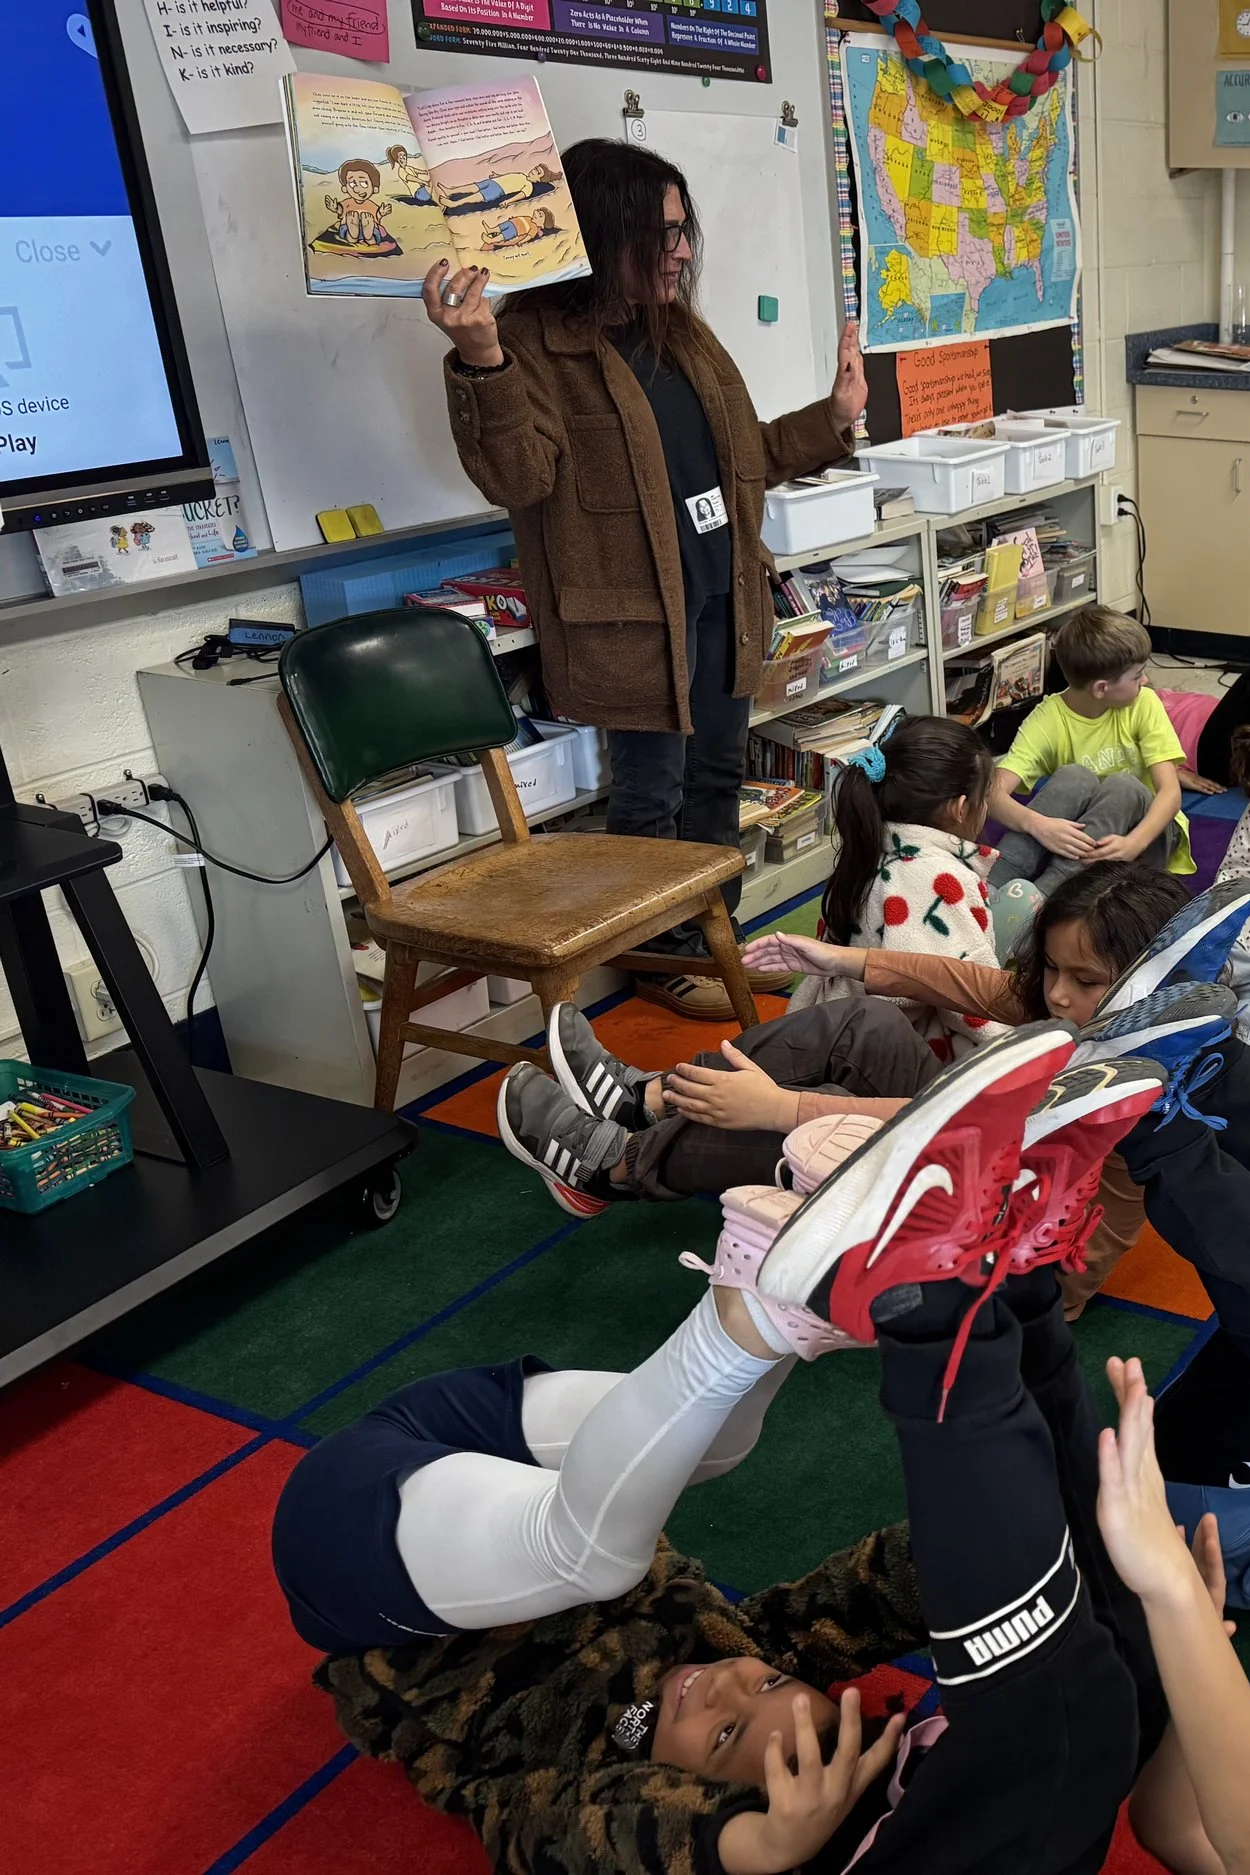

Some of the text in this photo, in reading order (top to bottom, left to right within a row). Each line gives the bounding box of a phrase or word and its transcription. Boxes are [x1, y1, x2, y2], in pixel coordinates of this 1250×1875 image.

[175, 2, 186, 14] is
[189, 0, 198, 13] it
[202, 0, 248, 14] helpful?
[440, 3, 459, 13] Based
[459, 5, 468, 13] On
[476, 7, 500, 17] Position
[513, 11, 534, 21] Number
[520, 3, 534, 12] Digit
[570, 9, 582, 17] Zero
[582, 10, 594, 20] Acts
[605, 14, 634, 24] Placeholder
[179, 23, 191, 36] is
[192, 22, 202, 35] it
[205, 17, 262, 37] inspiring?
[345, 12, 379, 31] friend
[426, 22, 455, 33] XPANDED
[570, 19, 586, 28] There
[602, 23, 617, 32] Value
[630, 27, 650, 36] Column
[334, 32, 349, 42] and
[351, 36, 363, 46] I
[698, 36, 716, 44] Fraction
[170, 38, 278, 60] N- is it necessary?
[462, 38, 485, 48] Seventy
[486, 40, 497, 48] Five
[517, 43, 529, 51] Four
[530, 45, 550, 54] Hundred
[551, 47, 569, 57] Twenty
[604, 52, 618, 60] Three
[637, 56, 650, 65] Sixty
[650, 57, 662, 66] Eight
[178, 61, 254, 82] K- is it kind?
[635, 122, 645, 138] 3
[15, 239, 81, 263] Close
[914, 347, 979, 367] Good Sportsmanship
[902, 379, 919, 395] Good
[17, 396, 70, 415] device
[0, 433, 37, 456] Play
[182, 494, 241, 522] UCKET?
[245, 632, 286, 641] Lennon
[962, 1594, 1057, 1667] PUMA
[615, 1704, 638, 1736] FACE
[630, 1724, 649, 1743] THE
